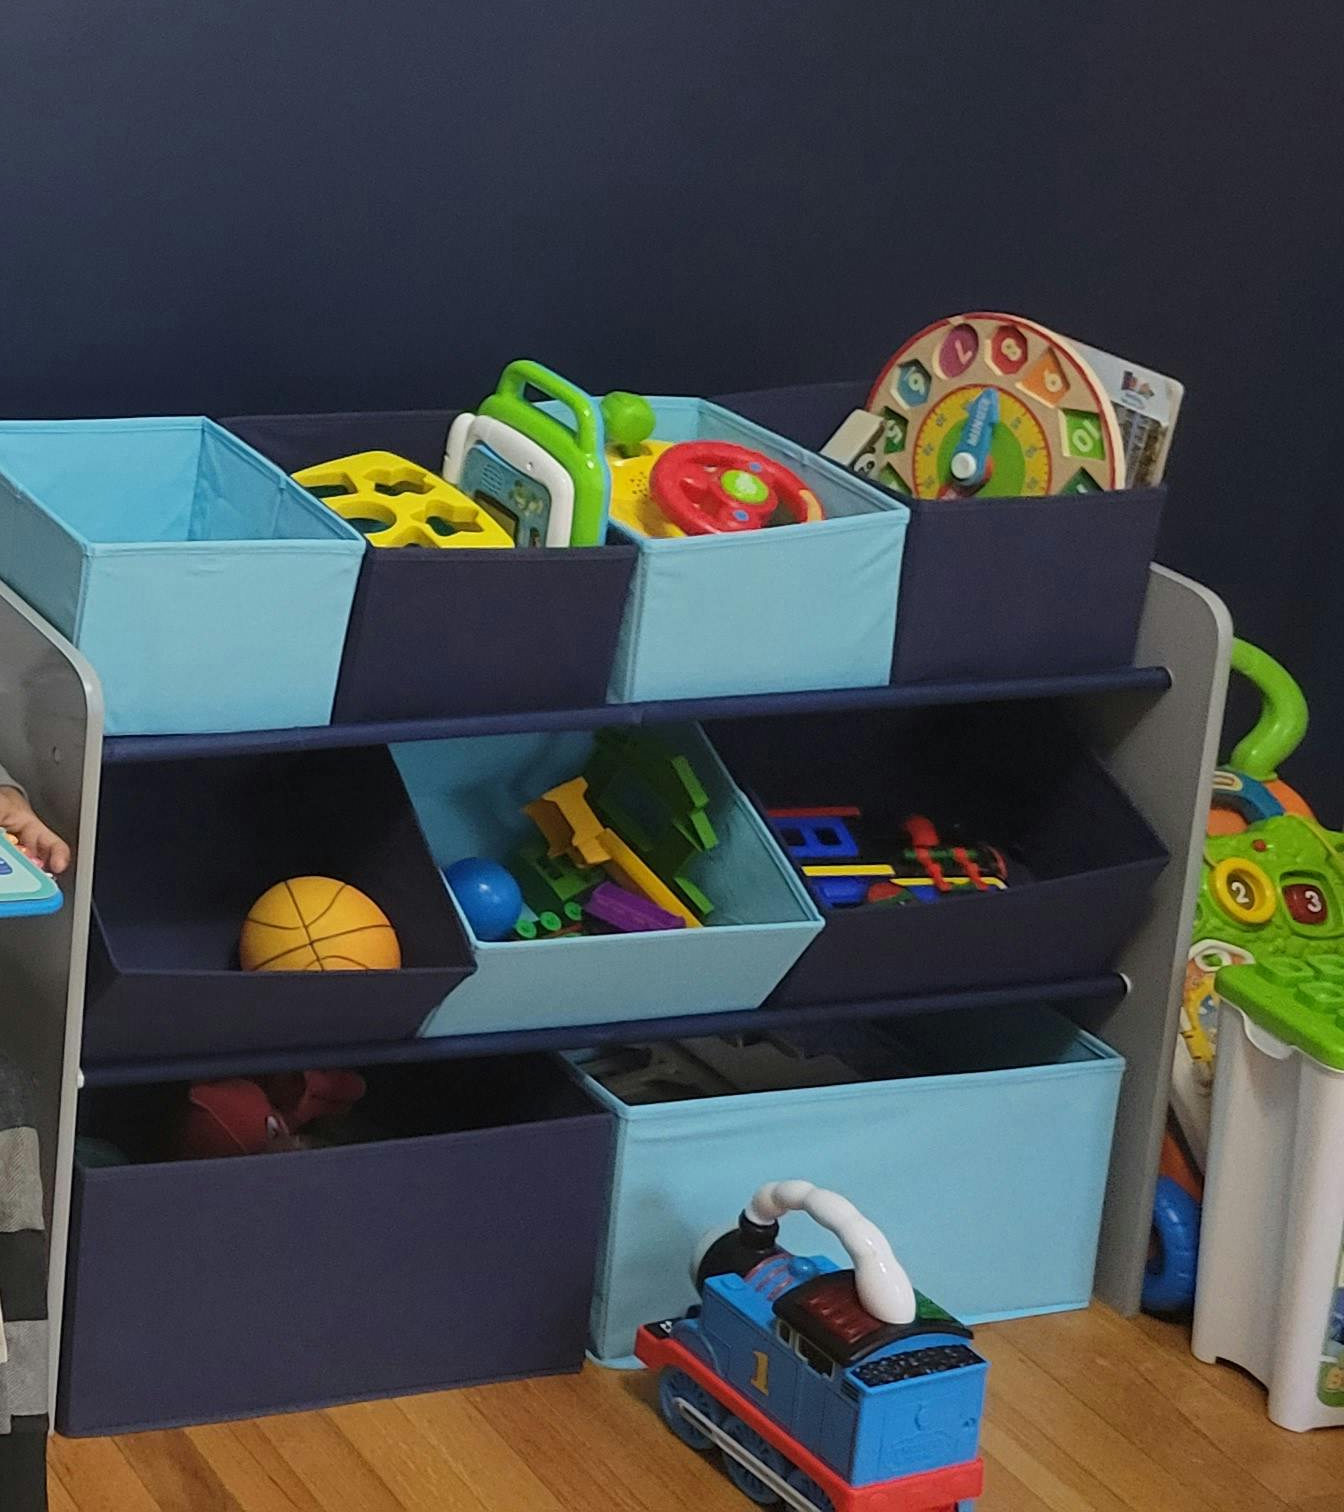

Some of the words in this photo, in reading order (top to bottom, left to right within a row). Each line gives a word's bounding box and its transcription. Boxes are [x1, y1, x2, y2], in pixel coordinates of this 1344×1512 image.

[1000, 337, 1021, 361] 8
[1071, 418, 1100, 453] 10
[1231, 881, 1250, 904] 2
[1304, 890, 1322, 913] 3
[750, 1351, 769, 1396] 1
